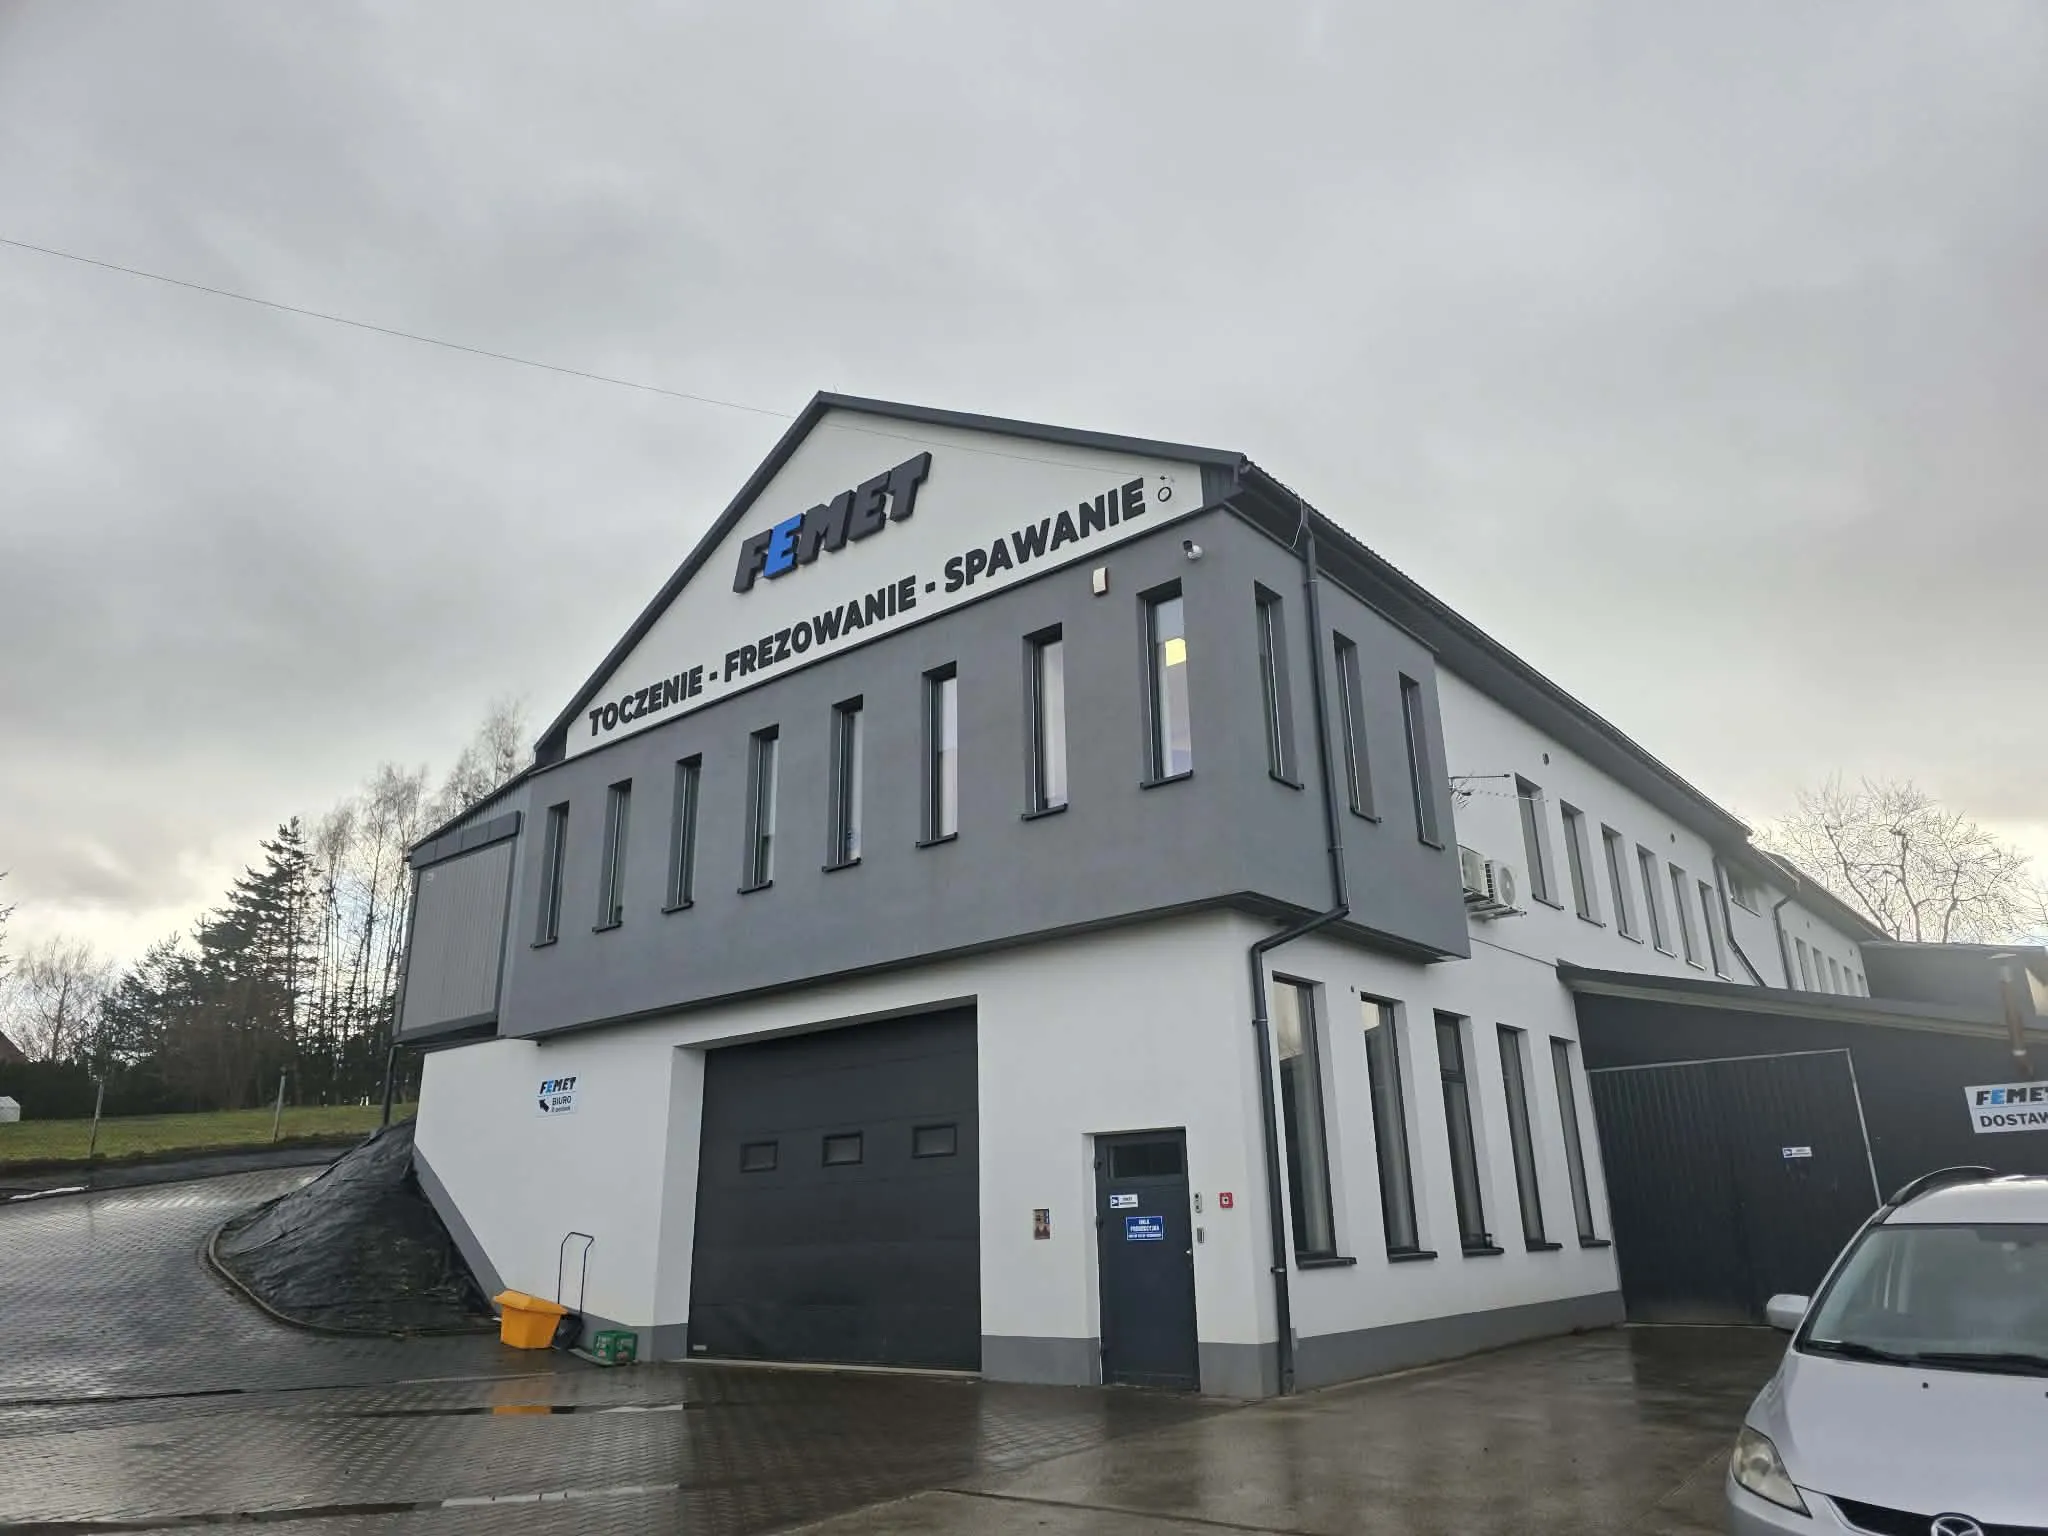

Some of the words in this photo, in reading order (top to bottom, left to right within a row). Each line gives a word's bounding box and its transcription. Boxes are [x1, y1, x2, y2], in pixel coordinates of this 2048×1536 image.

[733, 451, 932, 594] FEMET
[589, 664, 703, 736] TOCZENIE
[724, 575, 917, 682] FREZOWANIE
[944, 477, 1146, 594] SPAWANIE
[540, 1077, 576, 1094] FEMET
[552, 1096, 572, 1105] BIURO
